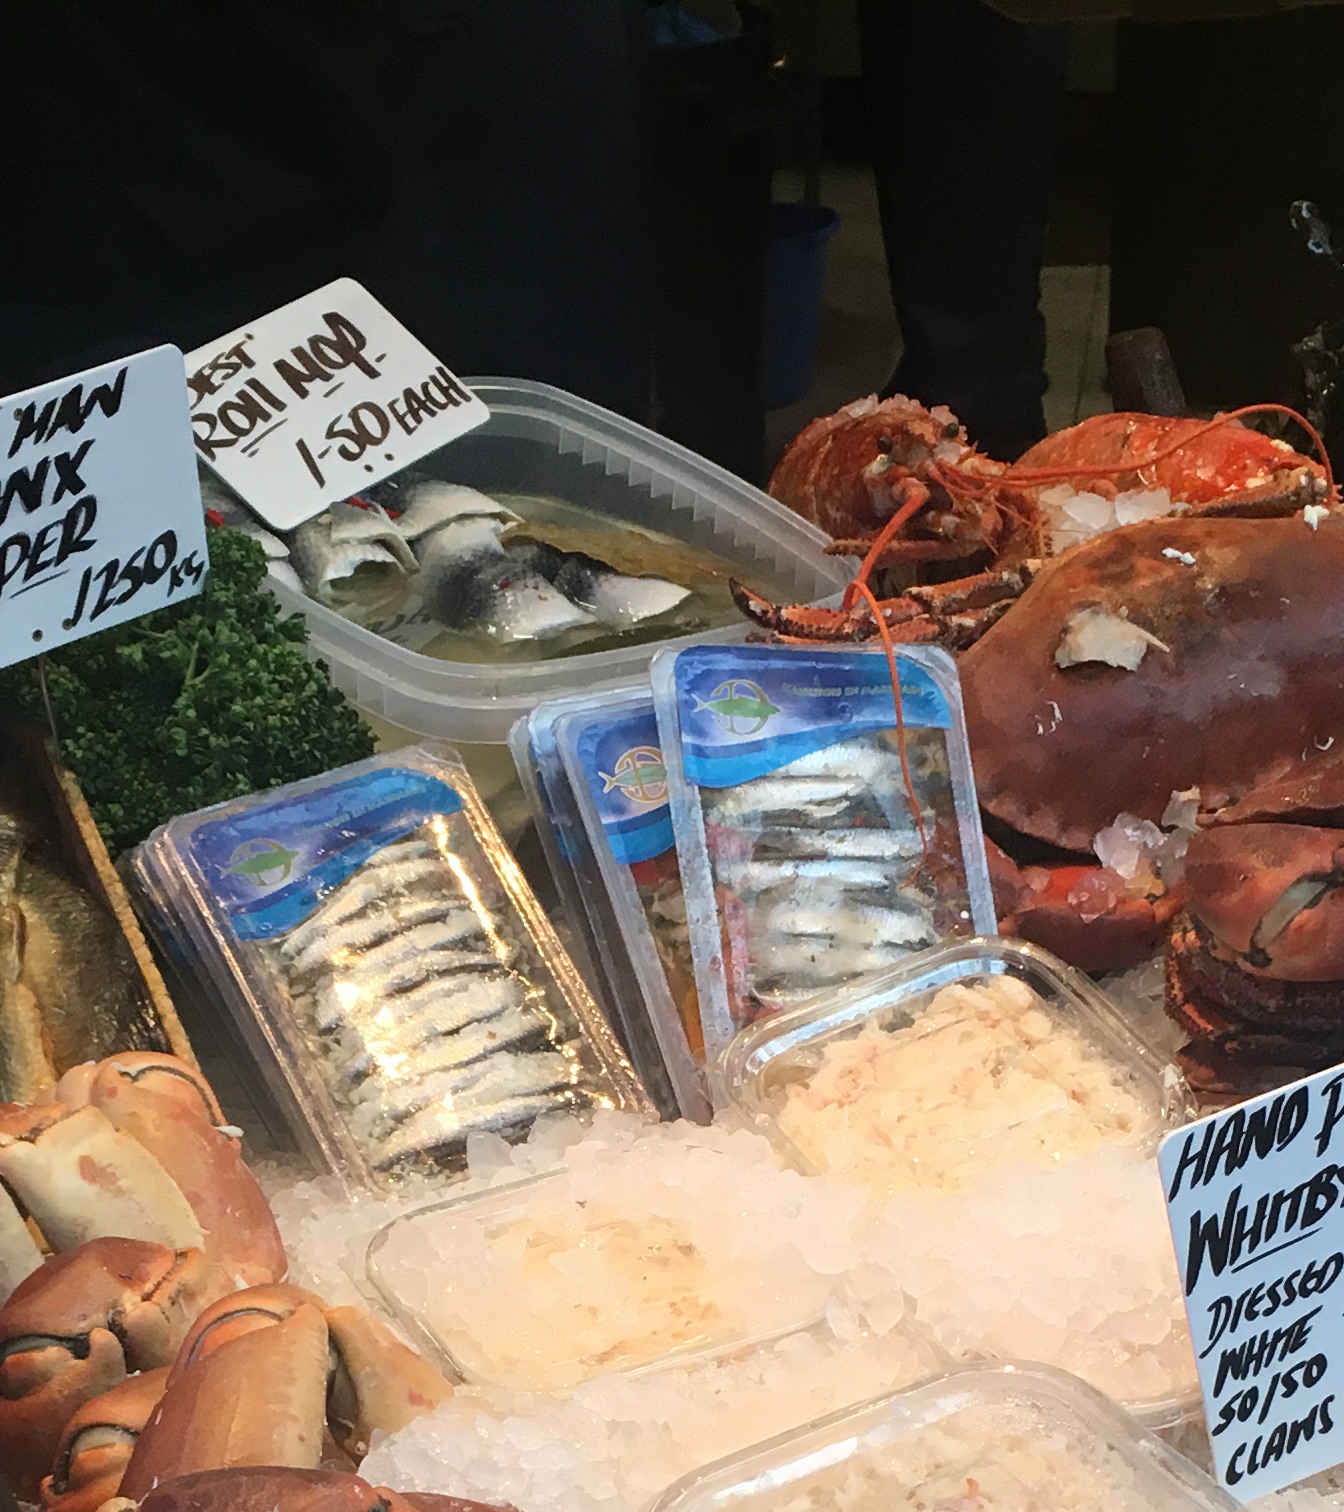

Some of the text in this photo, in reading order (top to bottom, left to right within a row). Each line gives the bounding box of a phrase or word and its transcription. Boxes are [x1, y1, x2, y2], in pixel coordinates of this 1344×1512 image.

[273, 311, 382, 400] MOP
[387, 366, 472, 436] EACH
[9, 367, 128, 458] MAN
[1169, 1087, 1309, 1203] HAND
[1212, 1354, 1327, 1436] 50/50
[1213, 1305, 1323, 1398] WHITE
[1225, 1395, 1335, 1486] CLAWS
